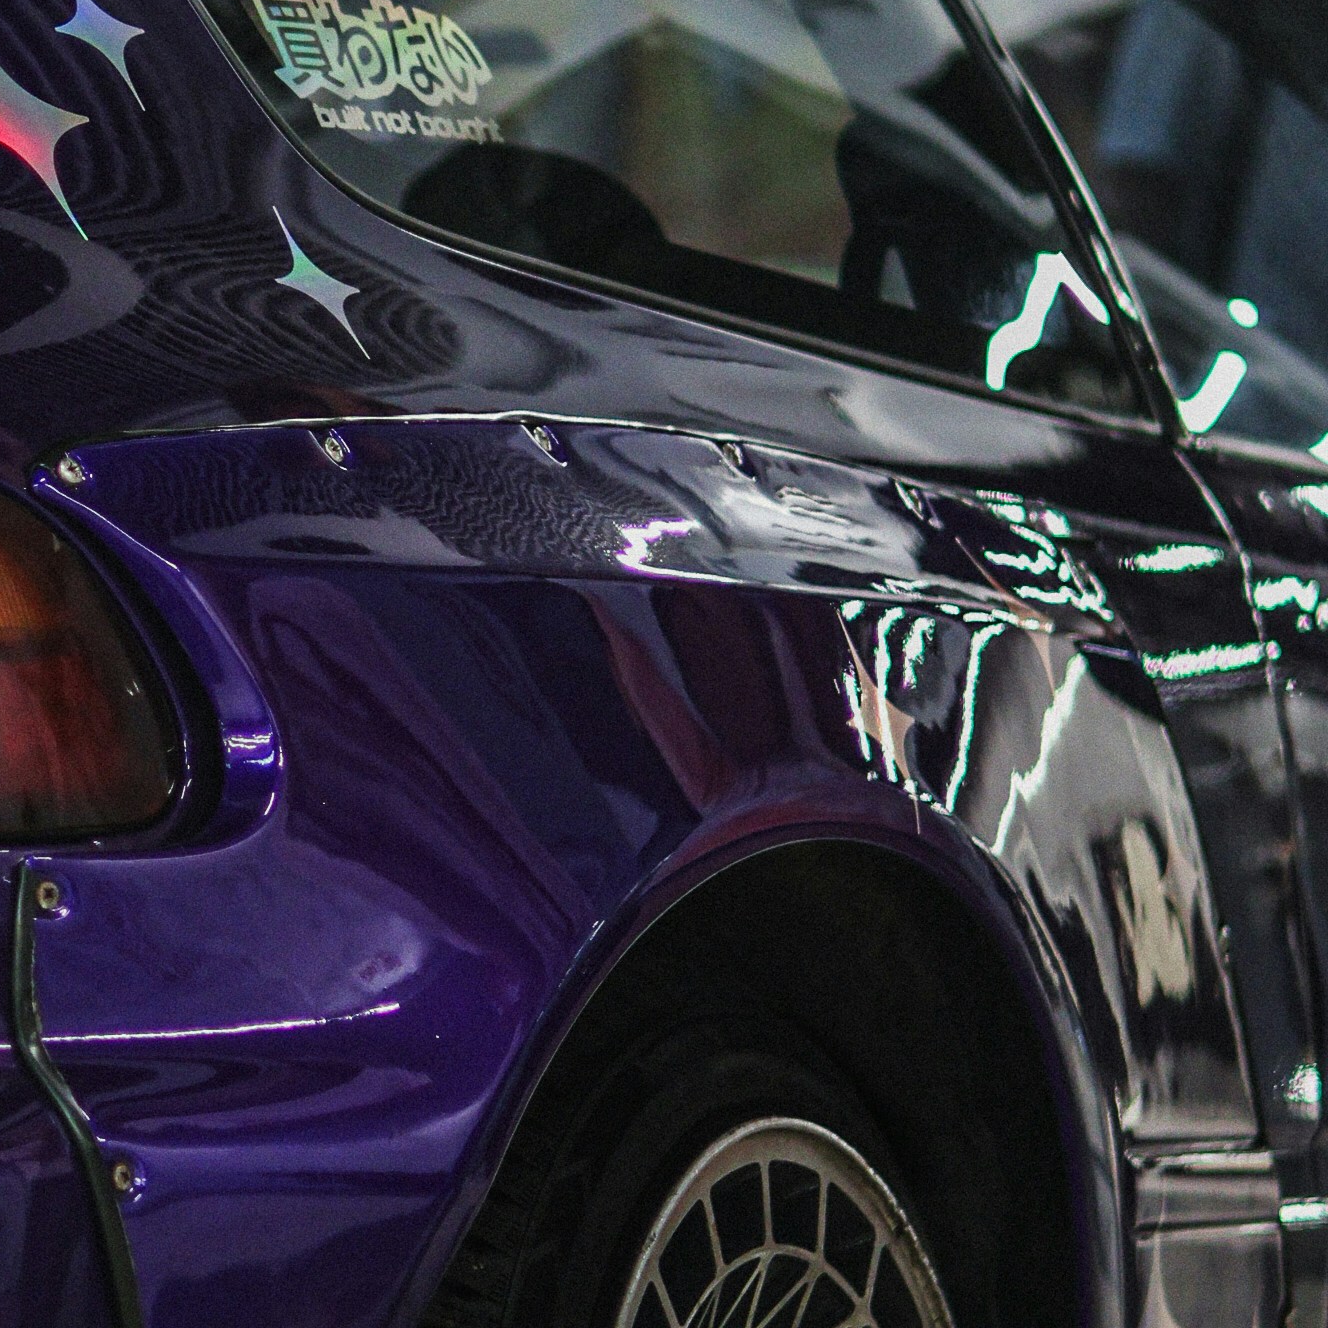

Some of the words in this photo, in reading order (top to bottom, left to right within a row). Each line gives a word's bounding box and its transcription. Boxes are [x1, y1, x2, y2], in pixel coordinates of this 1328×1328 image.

[313, 103, 371, 132] built
[372, 109, 416, 135] not
[414, 111, 504, 145] bought
